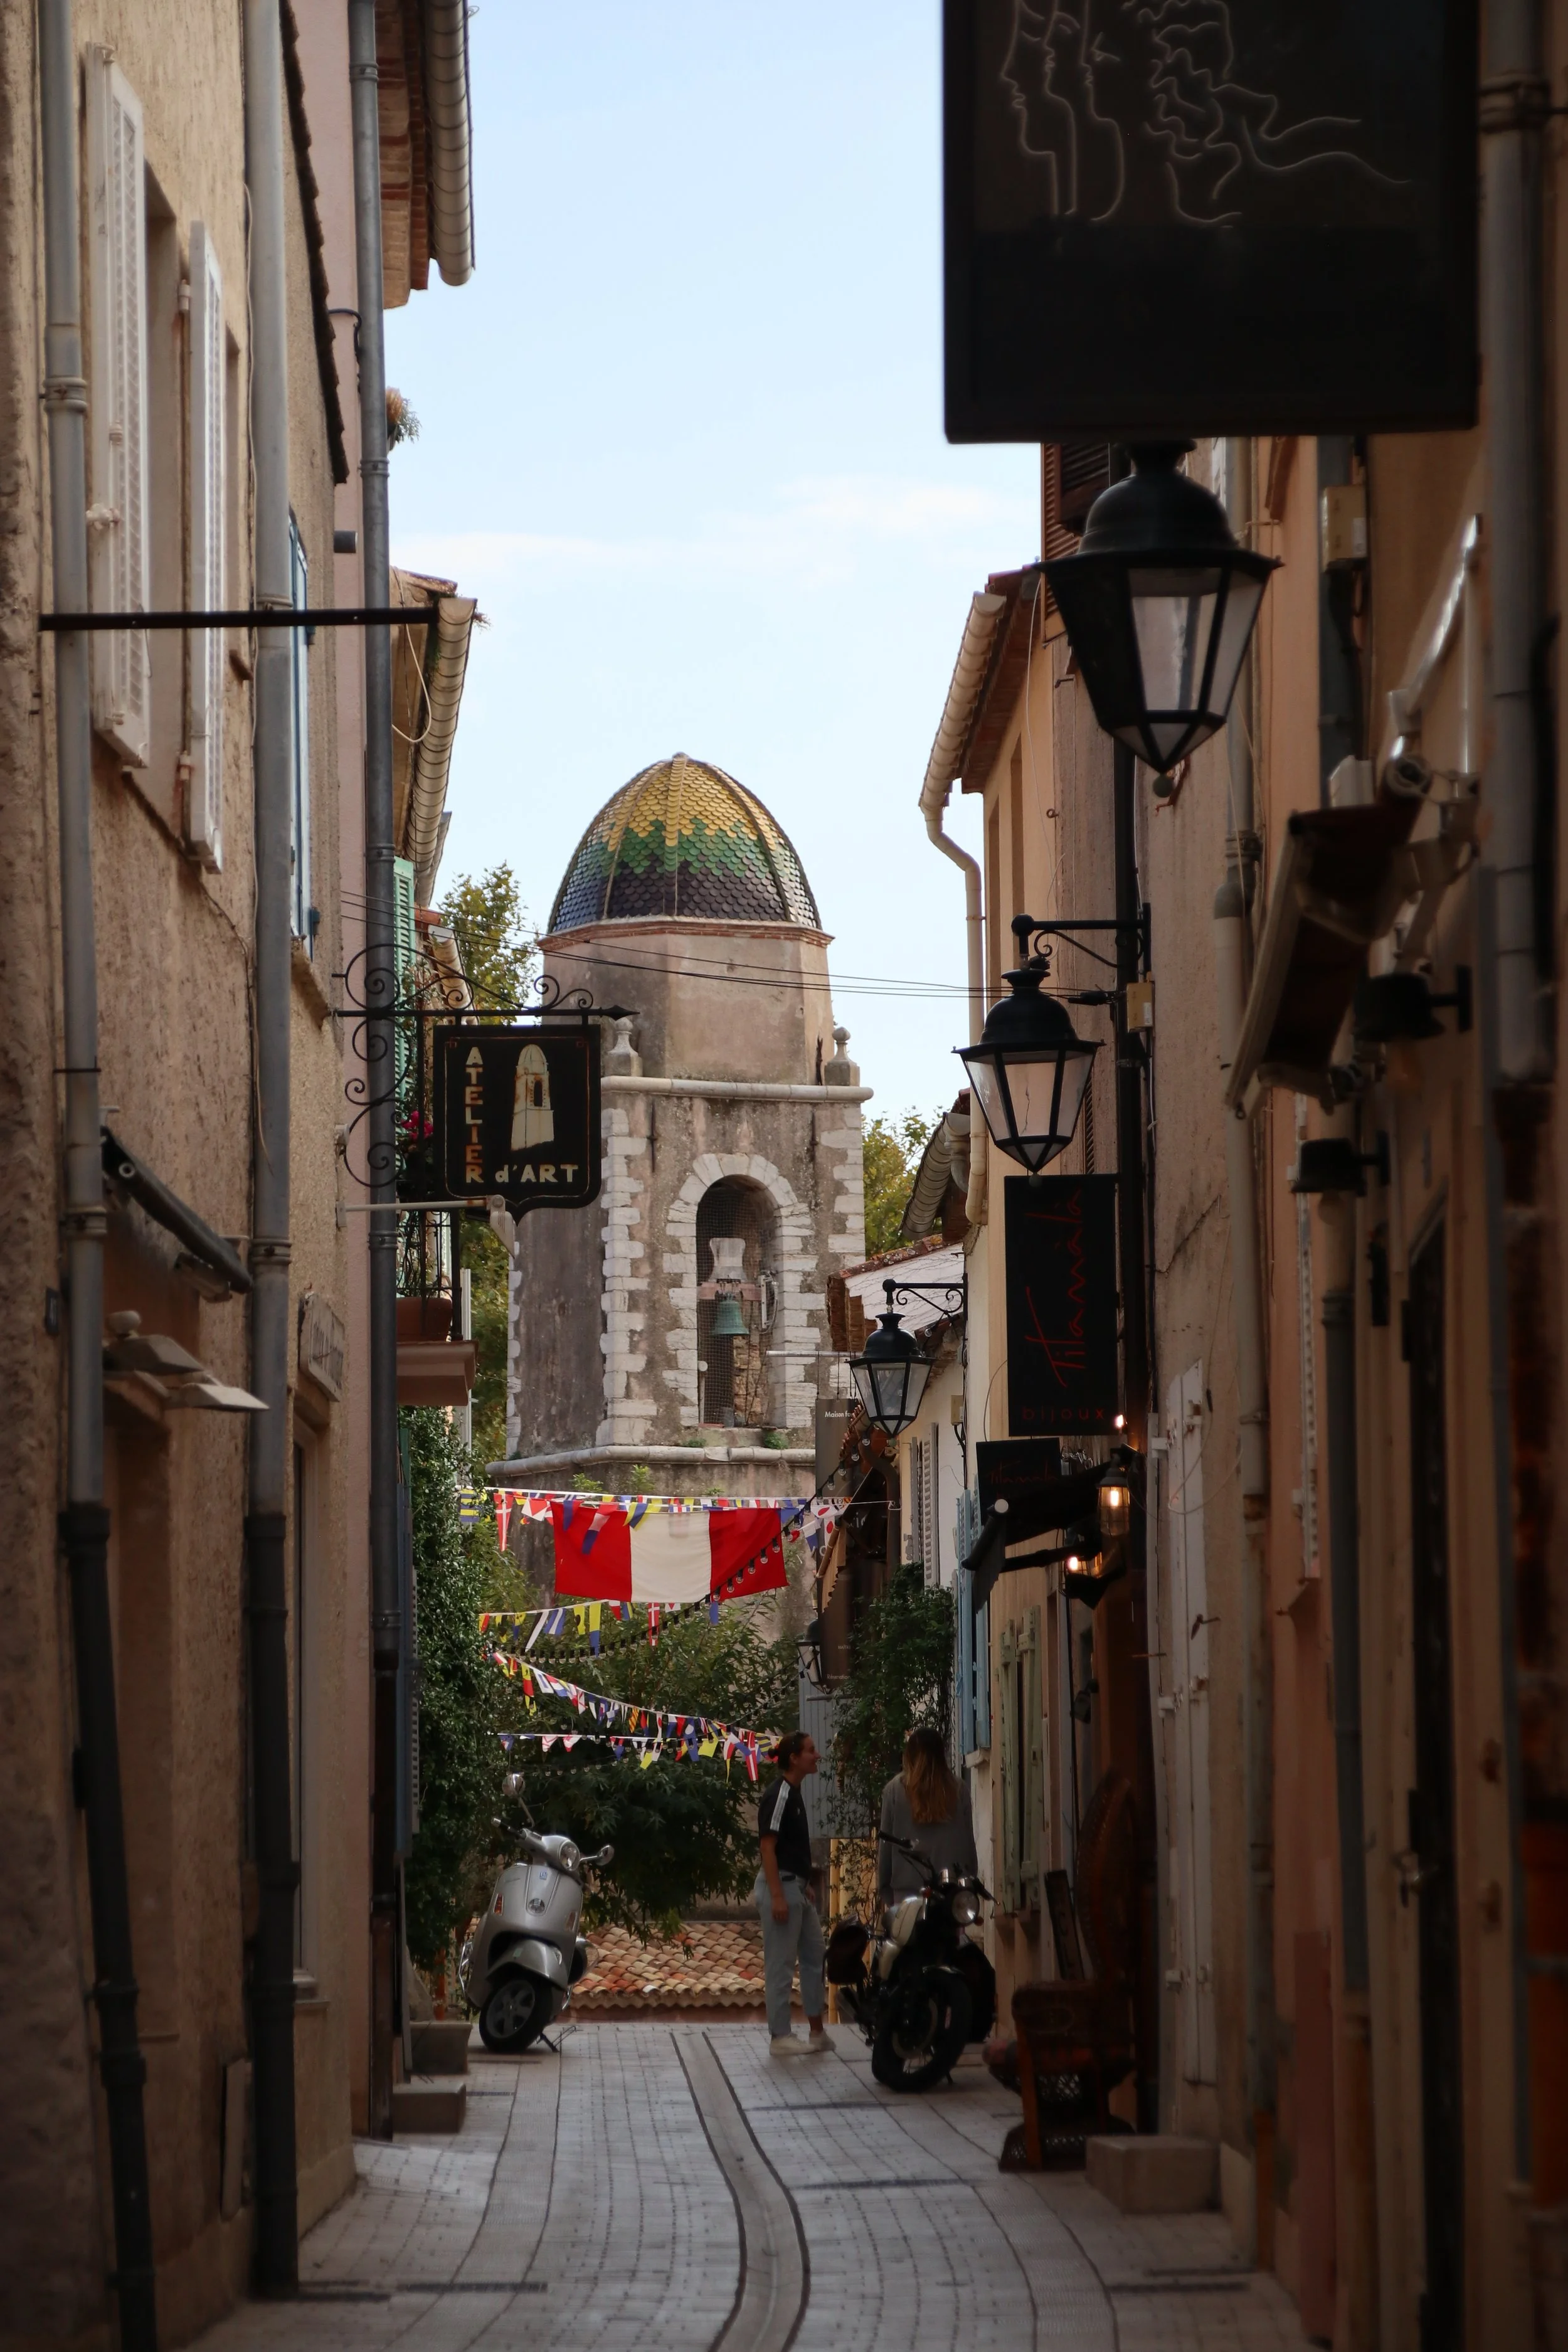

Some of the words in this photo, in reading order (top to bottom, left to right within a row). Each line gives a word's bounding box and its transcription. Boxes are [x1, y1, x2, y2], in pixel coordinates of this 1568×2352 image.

[465, 1046, 484, 1184] ATELIER
[495, 1164, 579, 1183] d'ART
[1022, 1405, 1105, 1423] bijoux
